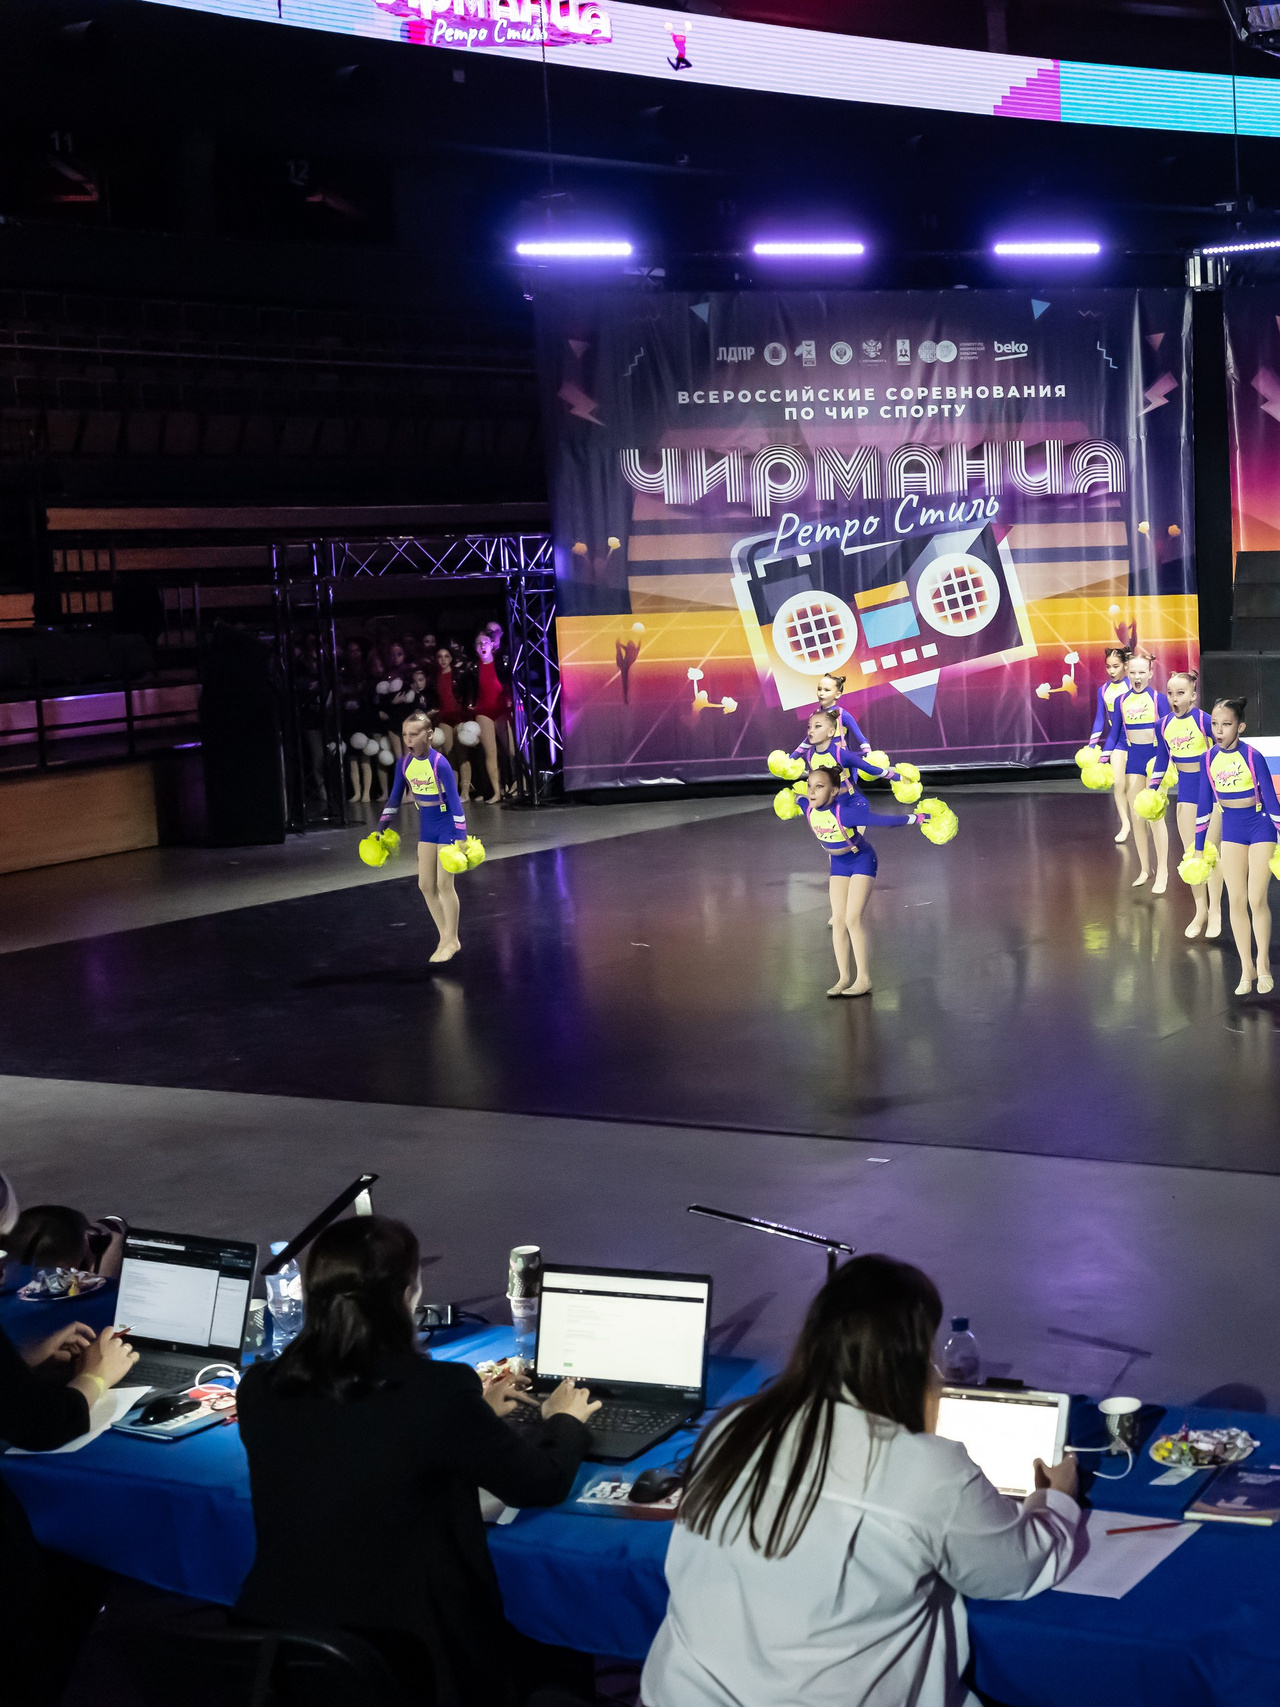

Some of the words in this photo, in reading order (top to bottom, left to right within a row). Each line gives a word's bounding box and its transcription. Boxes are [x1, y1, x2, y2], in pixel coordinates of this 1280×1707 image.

[432, 18, 487, 47] Ретро
[494, 19, 549, 44] Стиль
[716, 346, 755, 363] ЛДПР
[993, 340, 1029, 354] beko
[677, 386, 876, 404] ВСЕРОССИЙСКИЕ
[885, 384, 1067, 401] СОРЕВНОВАНИЯ
[784, 407, 815, 421] ПО
[825, 406, 870, 419] ЧИР
[879, 404, 967, 419] СПОРТУ
[773, 513, 881, 555] Ретро
[894, 495, 1000, 528] Стиль
